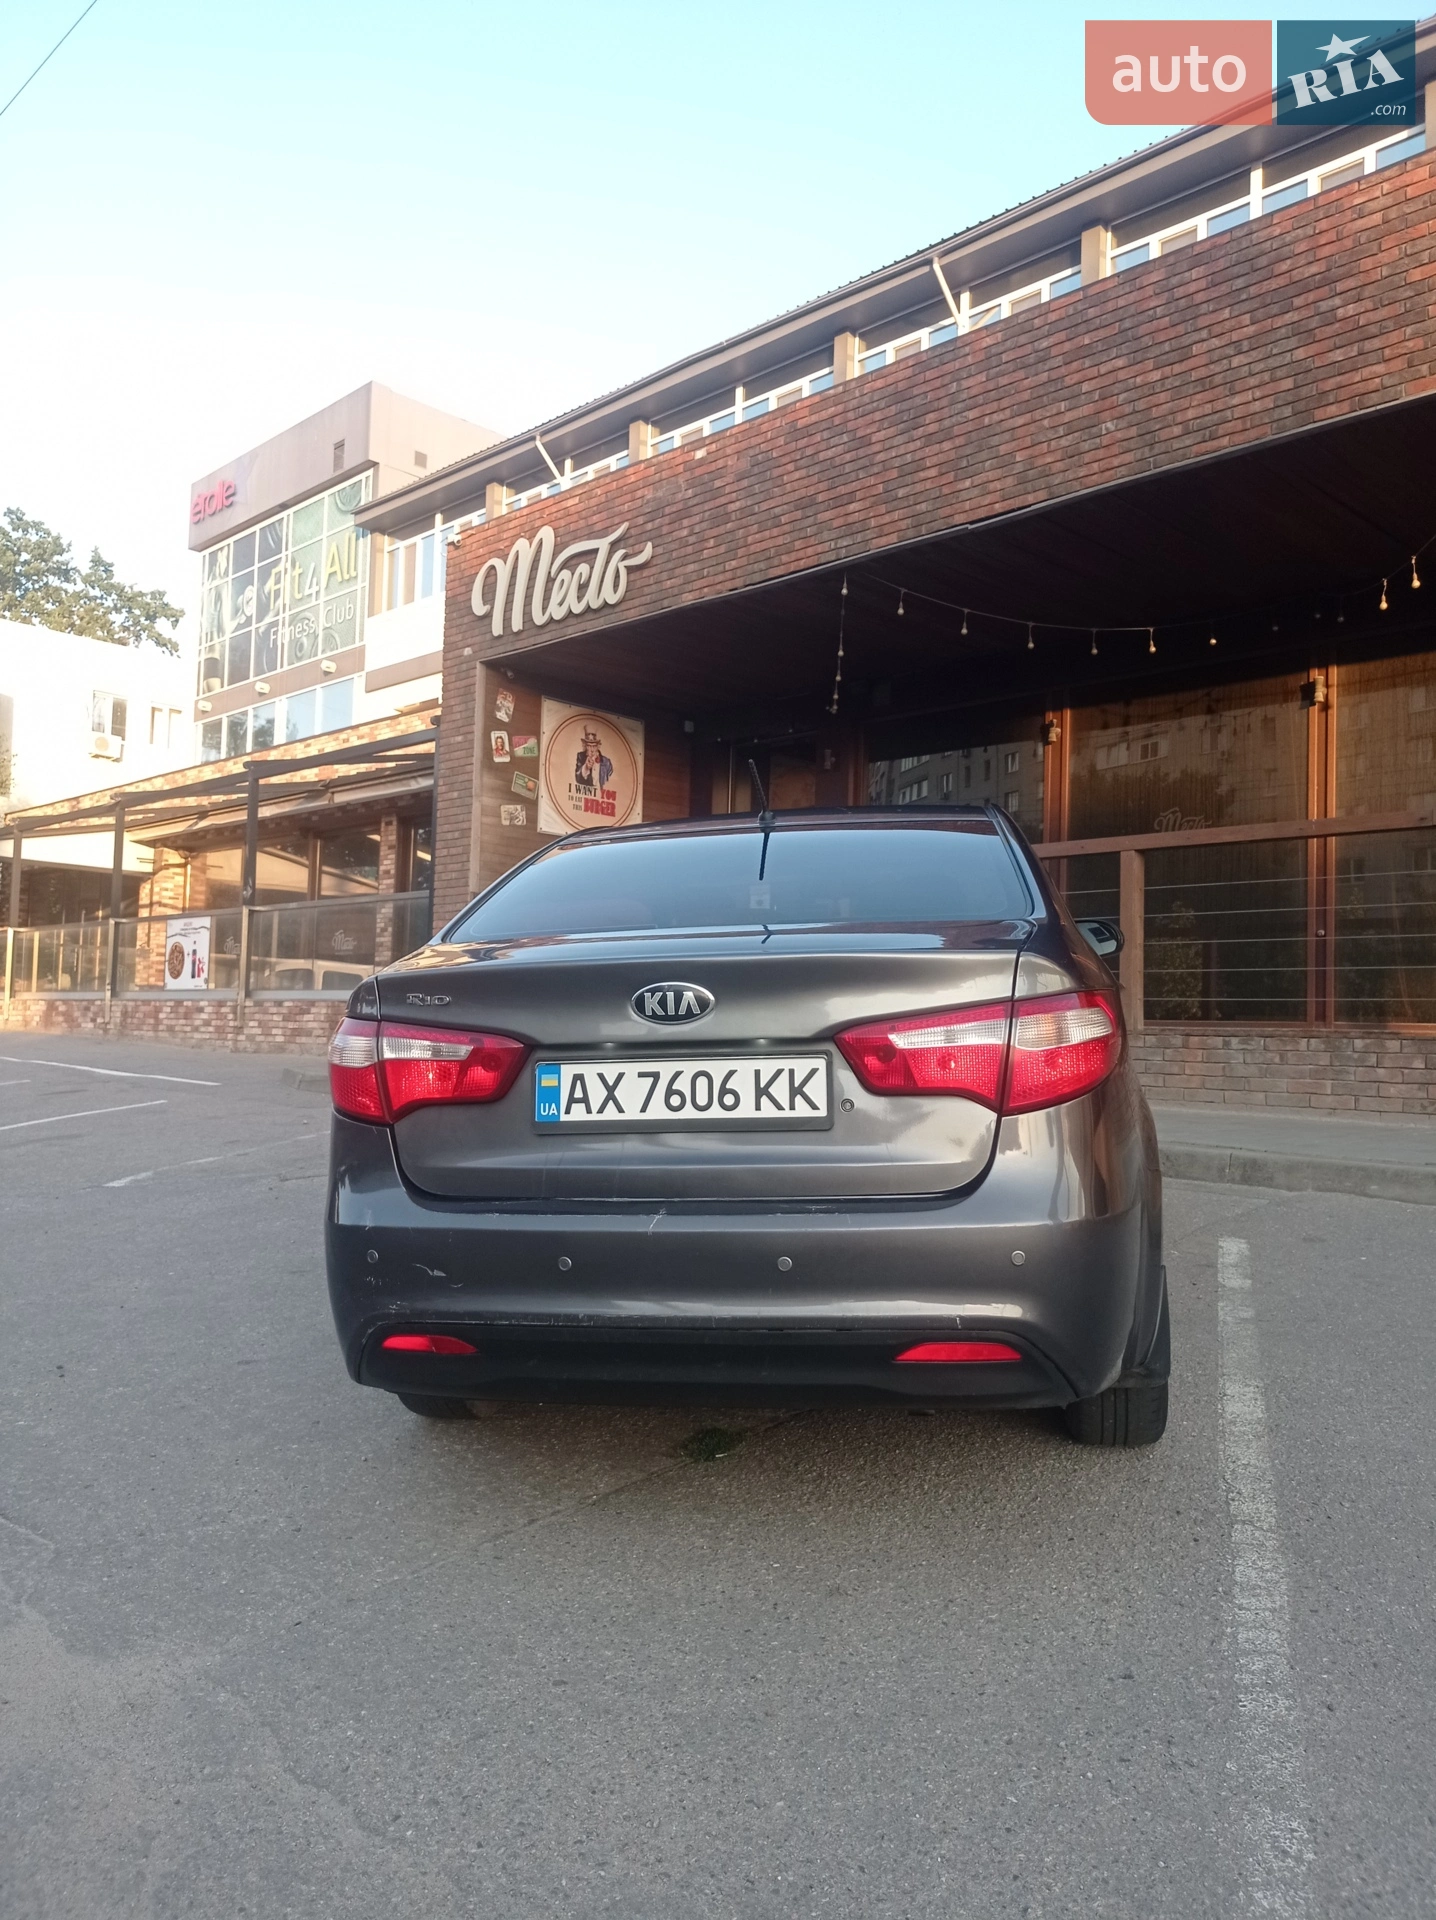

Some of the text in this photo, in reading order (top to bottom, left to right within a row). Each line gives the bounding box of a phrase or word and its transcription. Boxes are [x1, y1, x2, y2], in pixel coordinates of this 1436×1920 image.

[323, 597, 354, 628] Club
[575, 784, 597, 797] WANT
[600, 788, 617, 801] YOU
[644, 991, 701, 1015] KIA
[540, 1102, 558, 1116] UA
